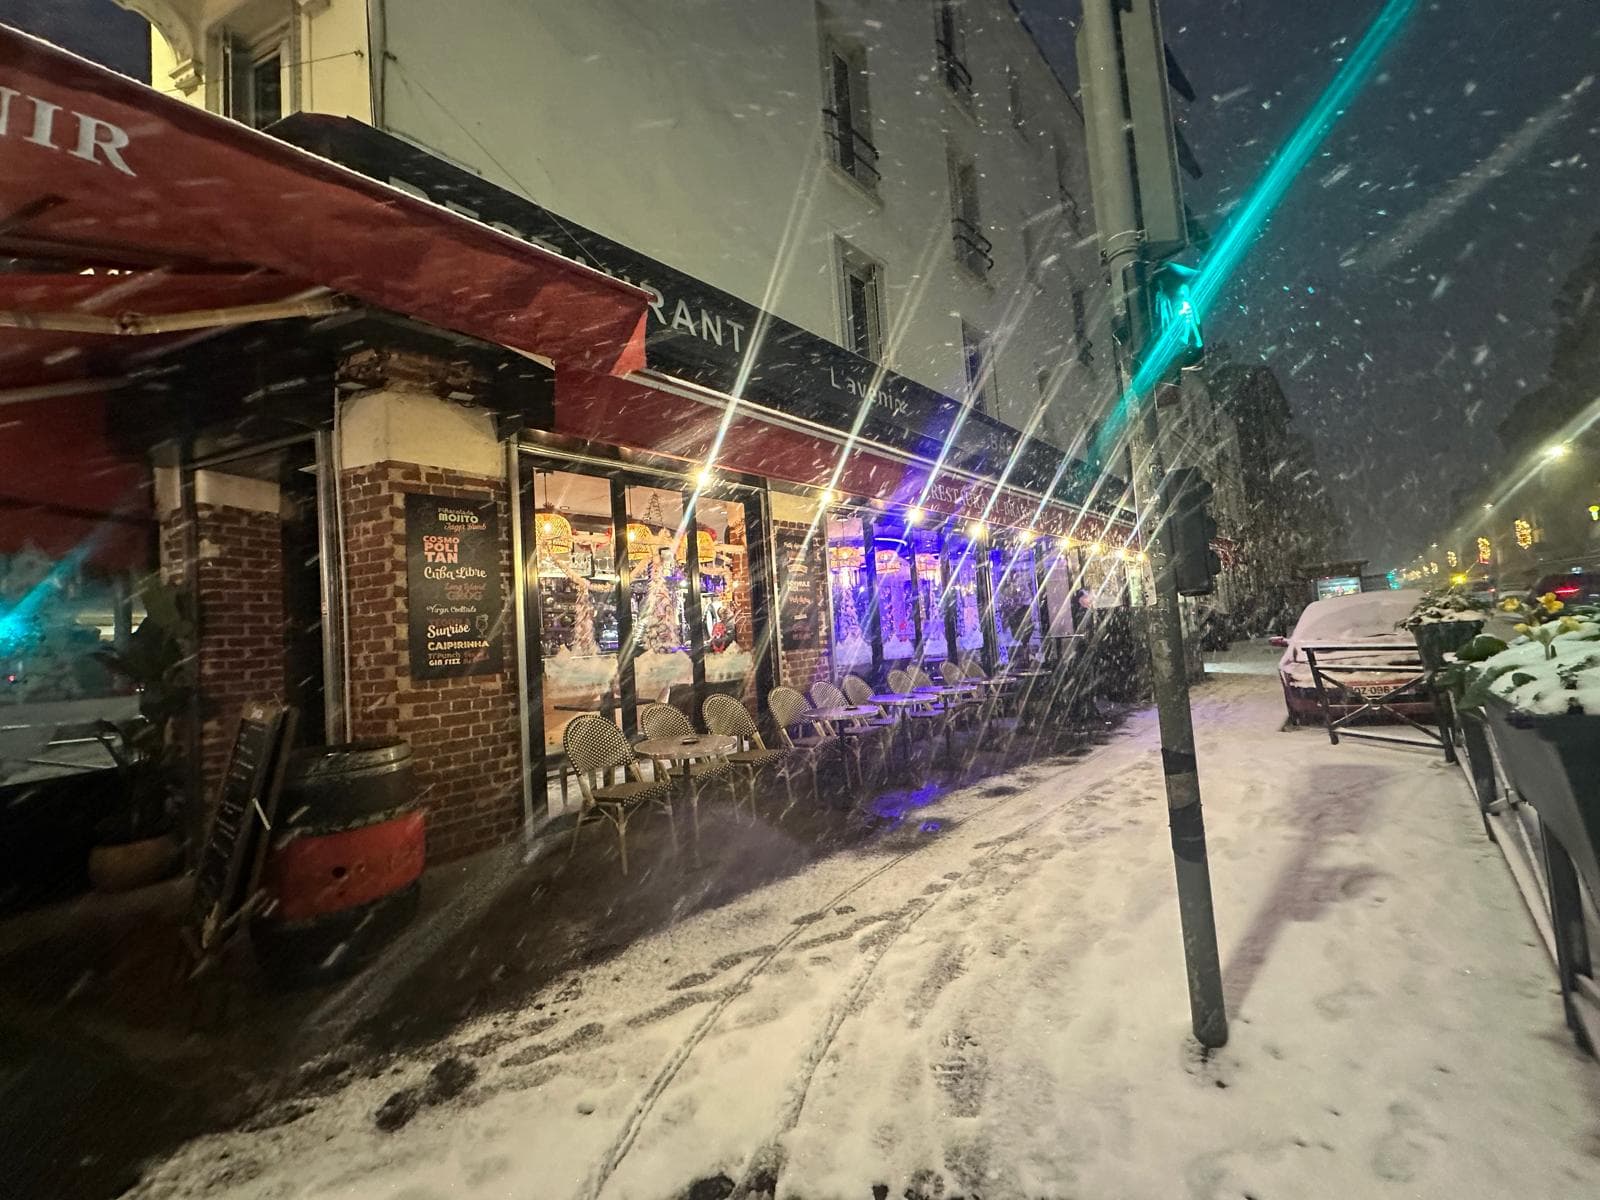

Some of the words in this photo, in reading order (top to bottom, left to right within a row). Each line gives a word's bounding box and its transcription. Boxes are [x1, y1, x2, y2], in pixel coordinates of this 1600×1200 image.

[438, 513, 479, 524] MOJITO
[423, 535, 460, 544] COSMO
[424, 542, 459, 553] POLI
[424, 552, 459, 564] TAN
[424, 565, 456, 580] Cuba
[455, 566, 488, 579] Libre
[427, 623, 471, 639] Sunrise
[427, 640, 490, 651] CAIPIRINHA
